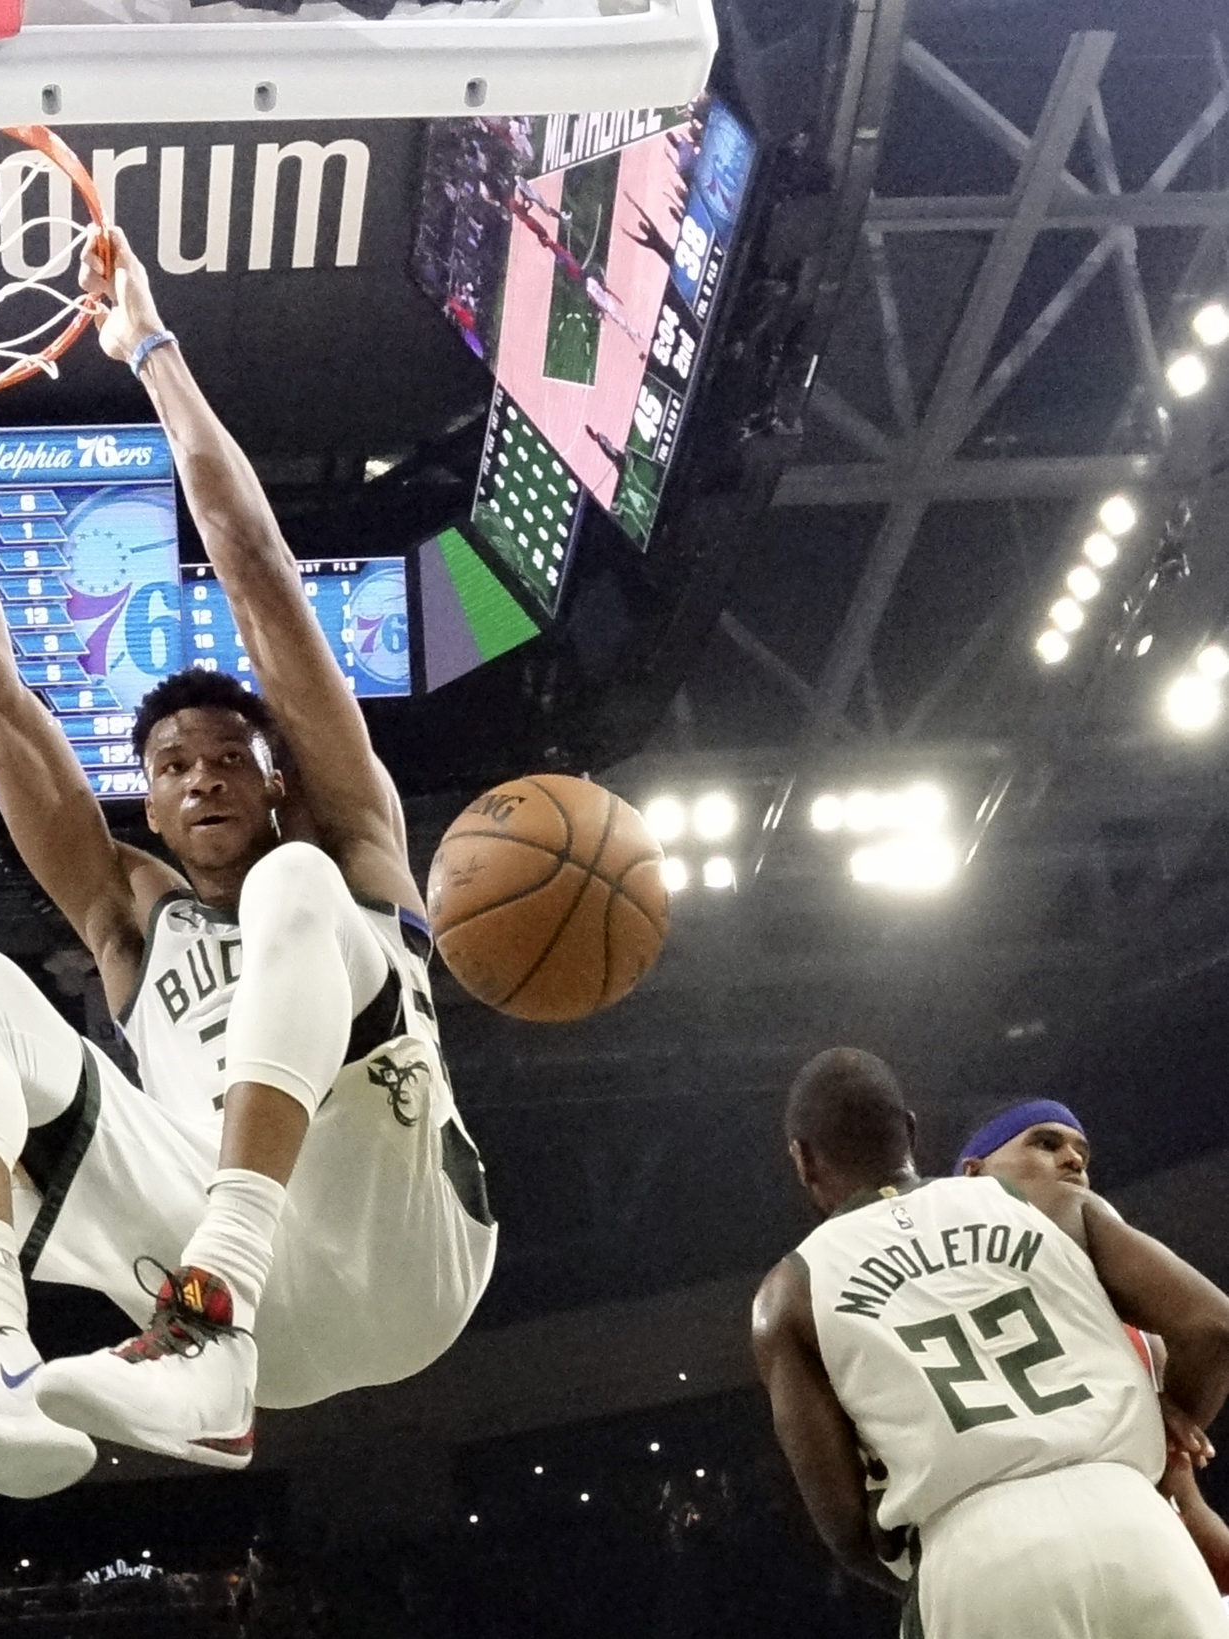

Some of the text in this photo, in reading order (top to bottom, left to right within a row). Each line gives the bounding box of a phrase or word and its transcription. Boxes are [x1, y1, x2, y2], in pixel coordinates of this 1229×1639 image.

[675, 215, 707, 281] 38
[652, 304, 679, 366] 5:04
[673, 328, 695, 379] 2nd
[634, 385, 663, 442] 45
[77, 435, 152, 467] 76ers
[23, 523, 32, 539] 1
[24, 550, 38, 566] 3
[28, 579, 42, 595] 5
[194, 581, 350, 600] 0 0 1
[25, 607, 48, 624] 13
[192, 605, 351, 625] 12 1
[44, 635, 59, 651] 3
[341, 630, 354, 642] 0
[237, 657, 250, 671] 2
[345, 654, 354, 666] 1
[46, 665, 61, 681] 5
[78, 691, 92, 708] 2
[98, 773, 148, 792] 75%
[155, 938, 243, 1024] BUC
[834, 1223, 1044, 1320] MIDDLETON
[893, 1285, 1095, 1434] 22
